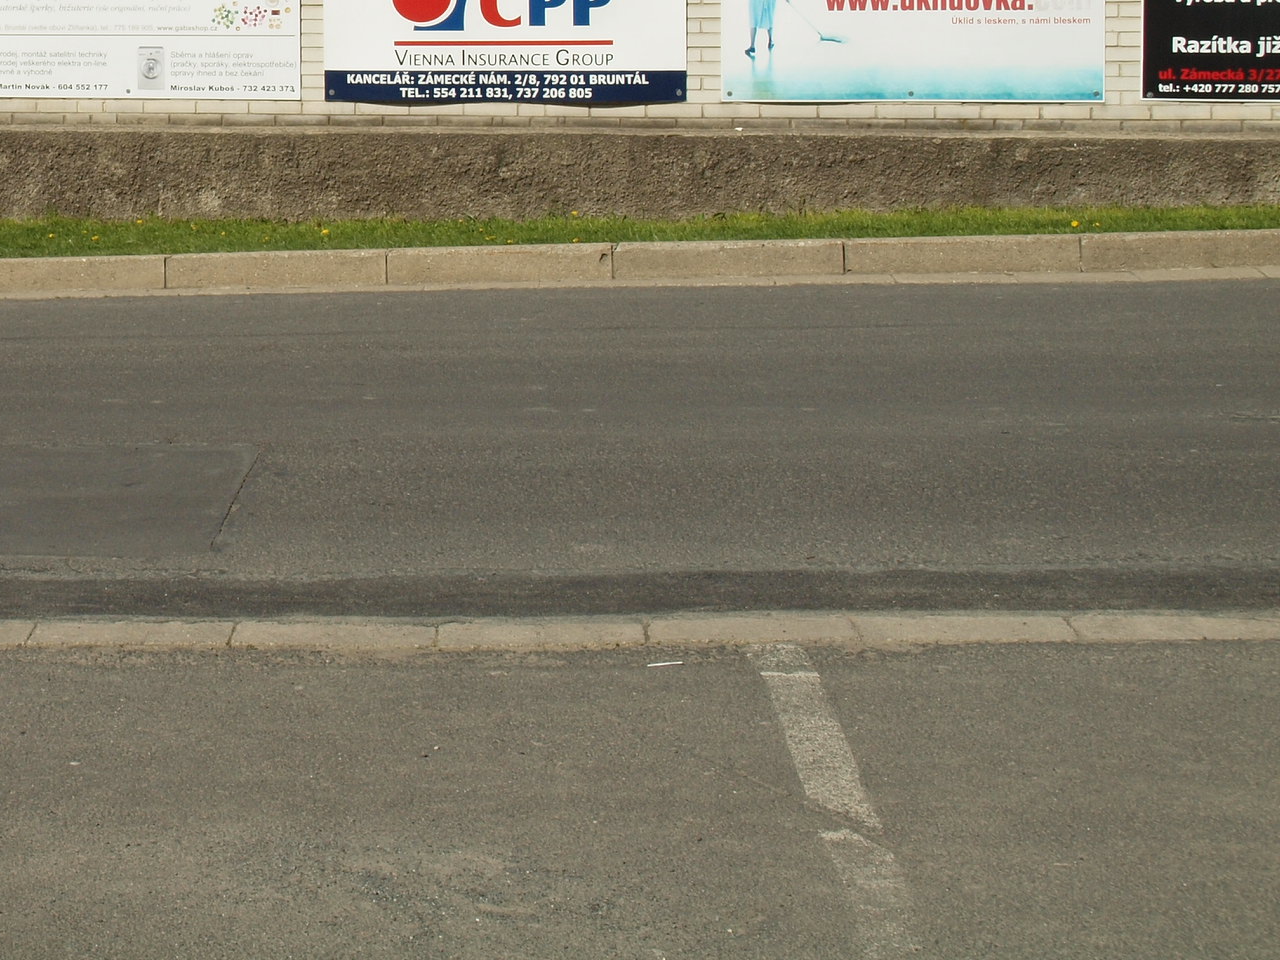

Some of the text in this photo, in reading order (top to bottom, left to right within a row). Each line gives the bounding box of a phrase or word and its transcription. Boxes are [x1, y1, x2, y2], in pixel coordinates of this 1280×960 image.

[952, 16, 974, 24] Úklid
[985, 17, 1019, 25] leskem,
[1030, 16, 1050, 24] námi
[1054, 16, 1090, 24] bleskem
[1172, 36, 1251, 53] Razítka
[347, 71, 649, 87] KANCELÁŘ: ZÁMECKÉ NÁM. 2/8, 792 01 BRUNTÁL
[1159, 69, 1176, 80] ul.
[1180, 68, 1244, 80] Zámecká
[400, 88, 592, 100] TEL.: 554 211 831, 737 206 805
[1158, 84, 1179, 92] tel.:
[1183, 84, 1212, 92] +420
[1238, 85, 1258, 93] 280
[1261, 85, 1280, 93] 757
